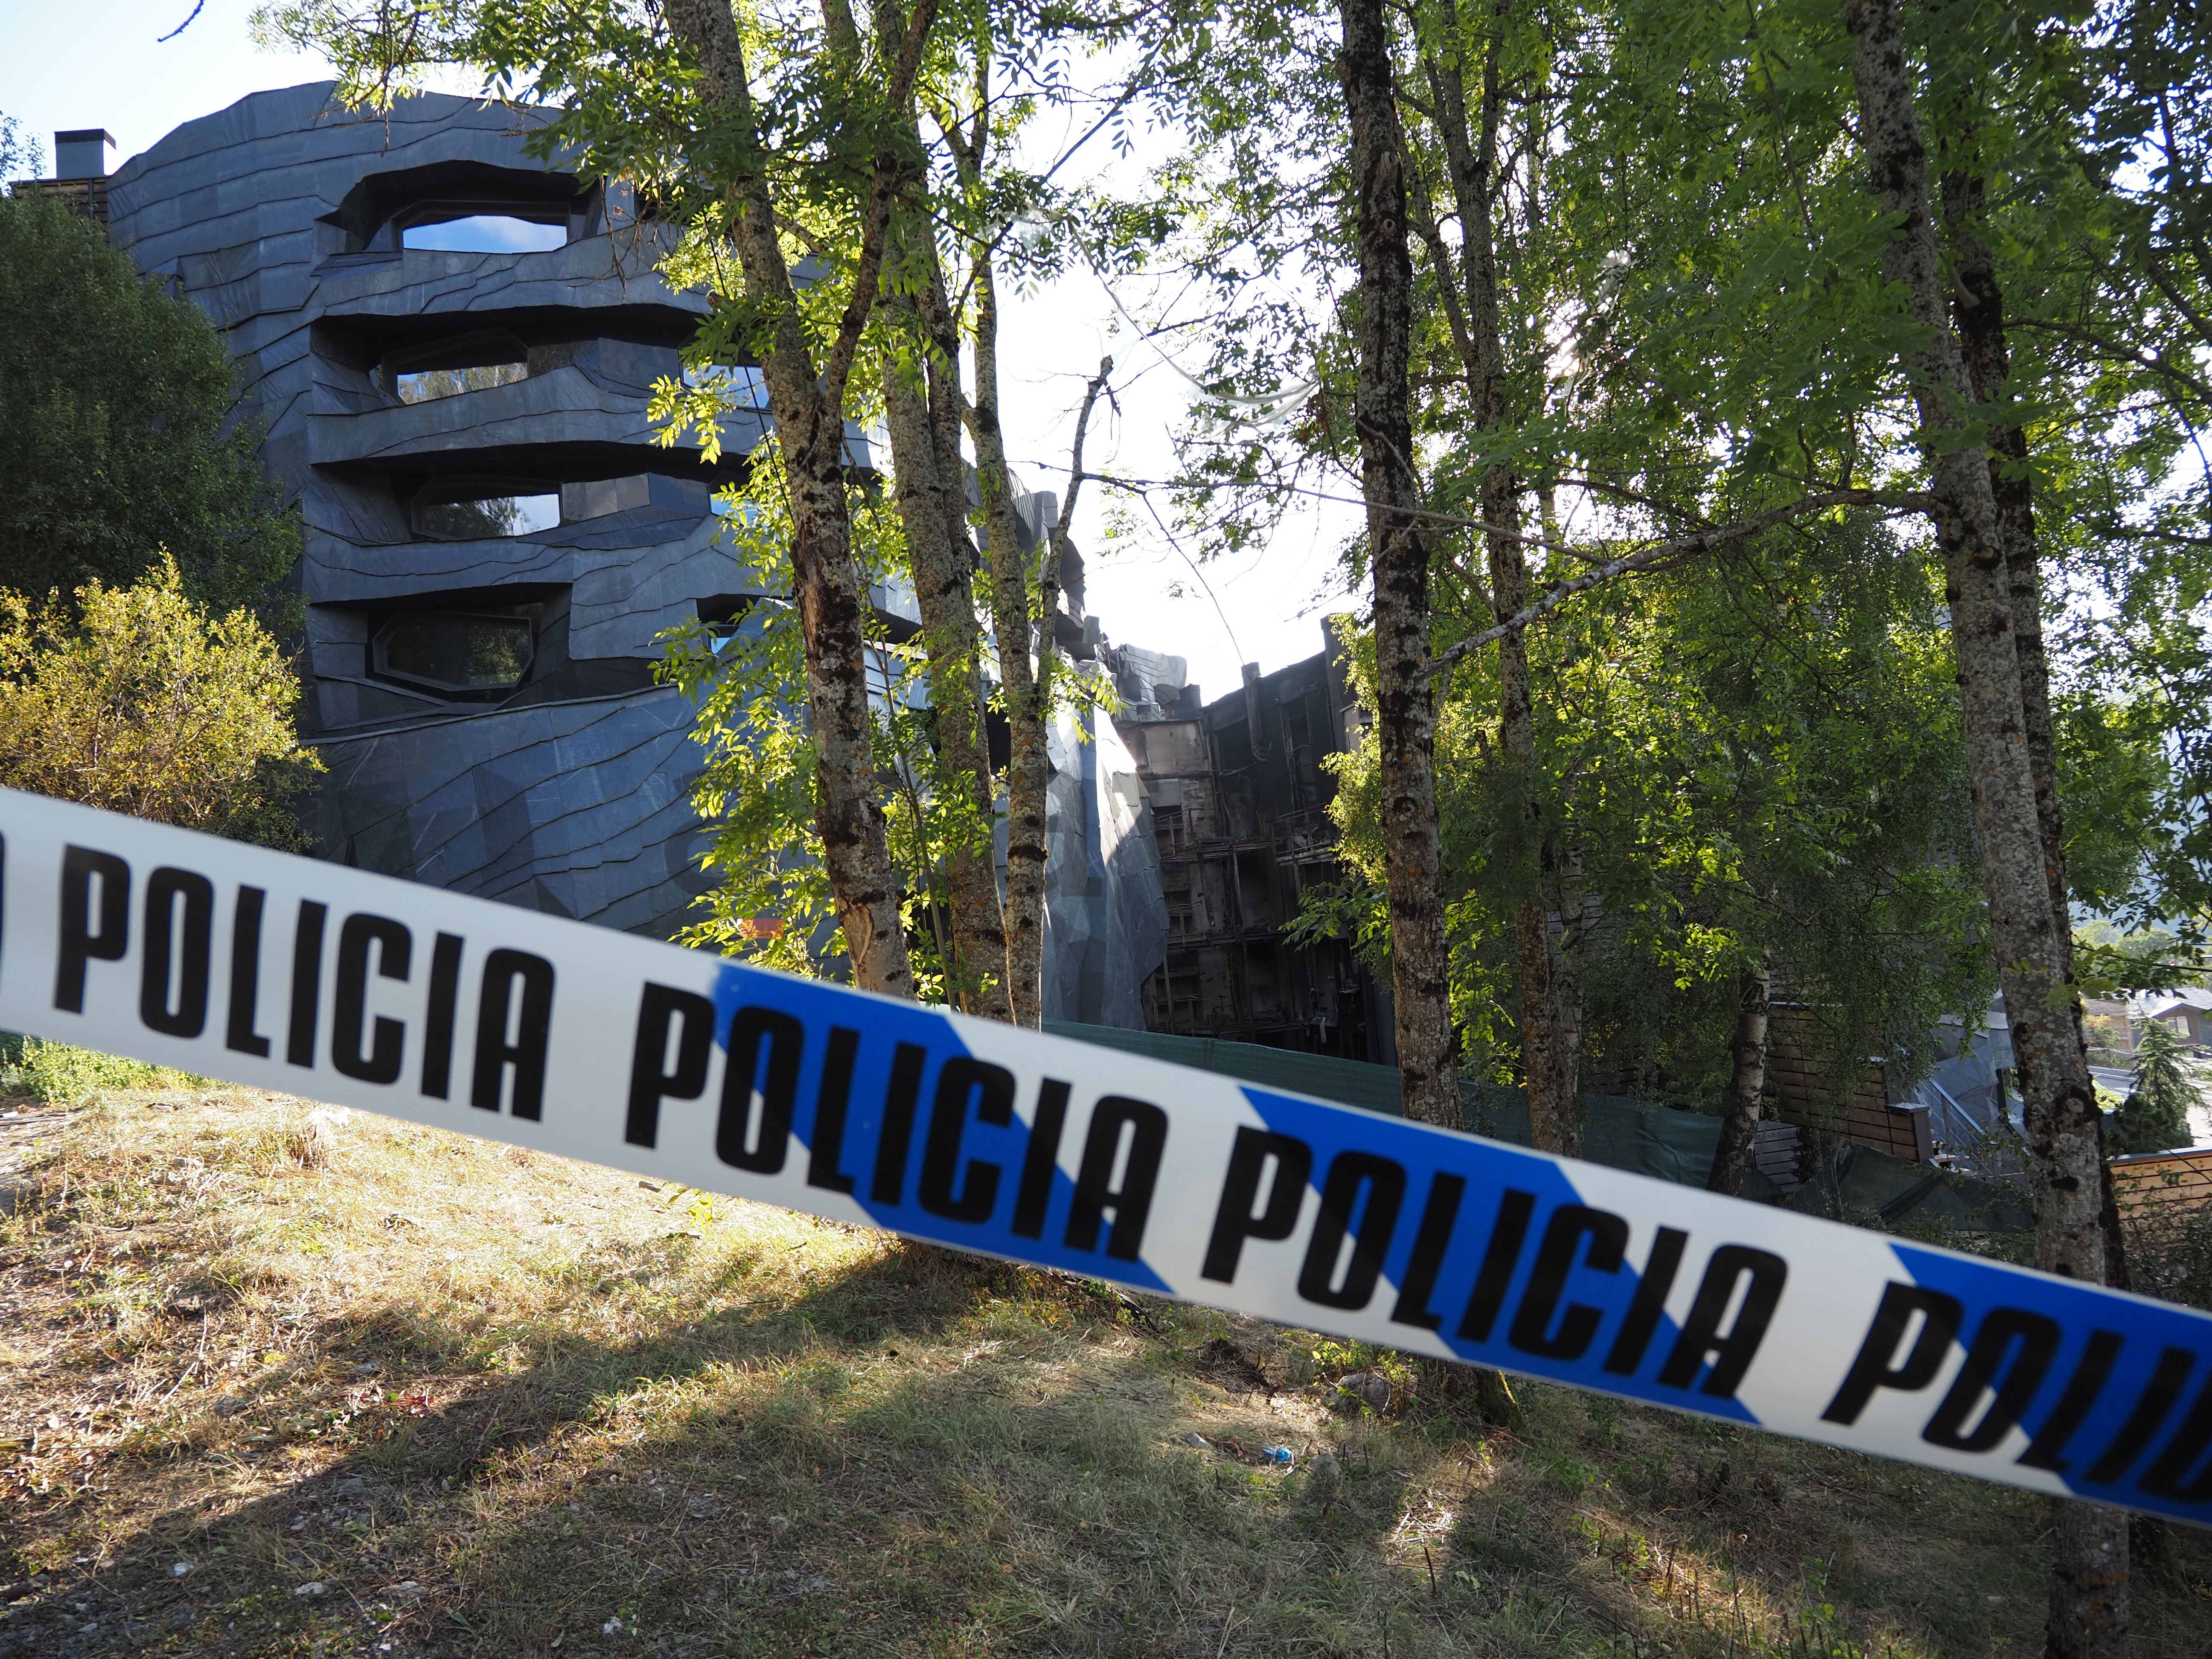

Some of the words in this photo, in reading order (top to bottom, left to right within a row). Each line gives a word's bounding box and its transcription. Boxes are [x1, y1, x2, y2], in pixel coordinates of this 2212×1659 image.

[54, 843, 556, 1123] POLICIA
[626, 981, 1169, 1262] POLICIA
[1201, 1124, 1789, 1399] POLICIA
